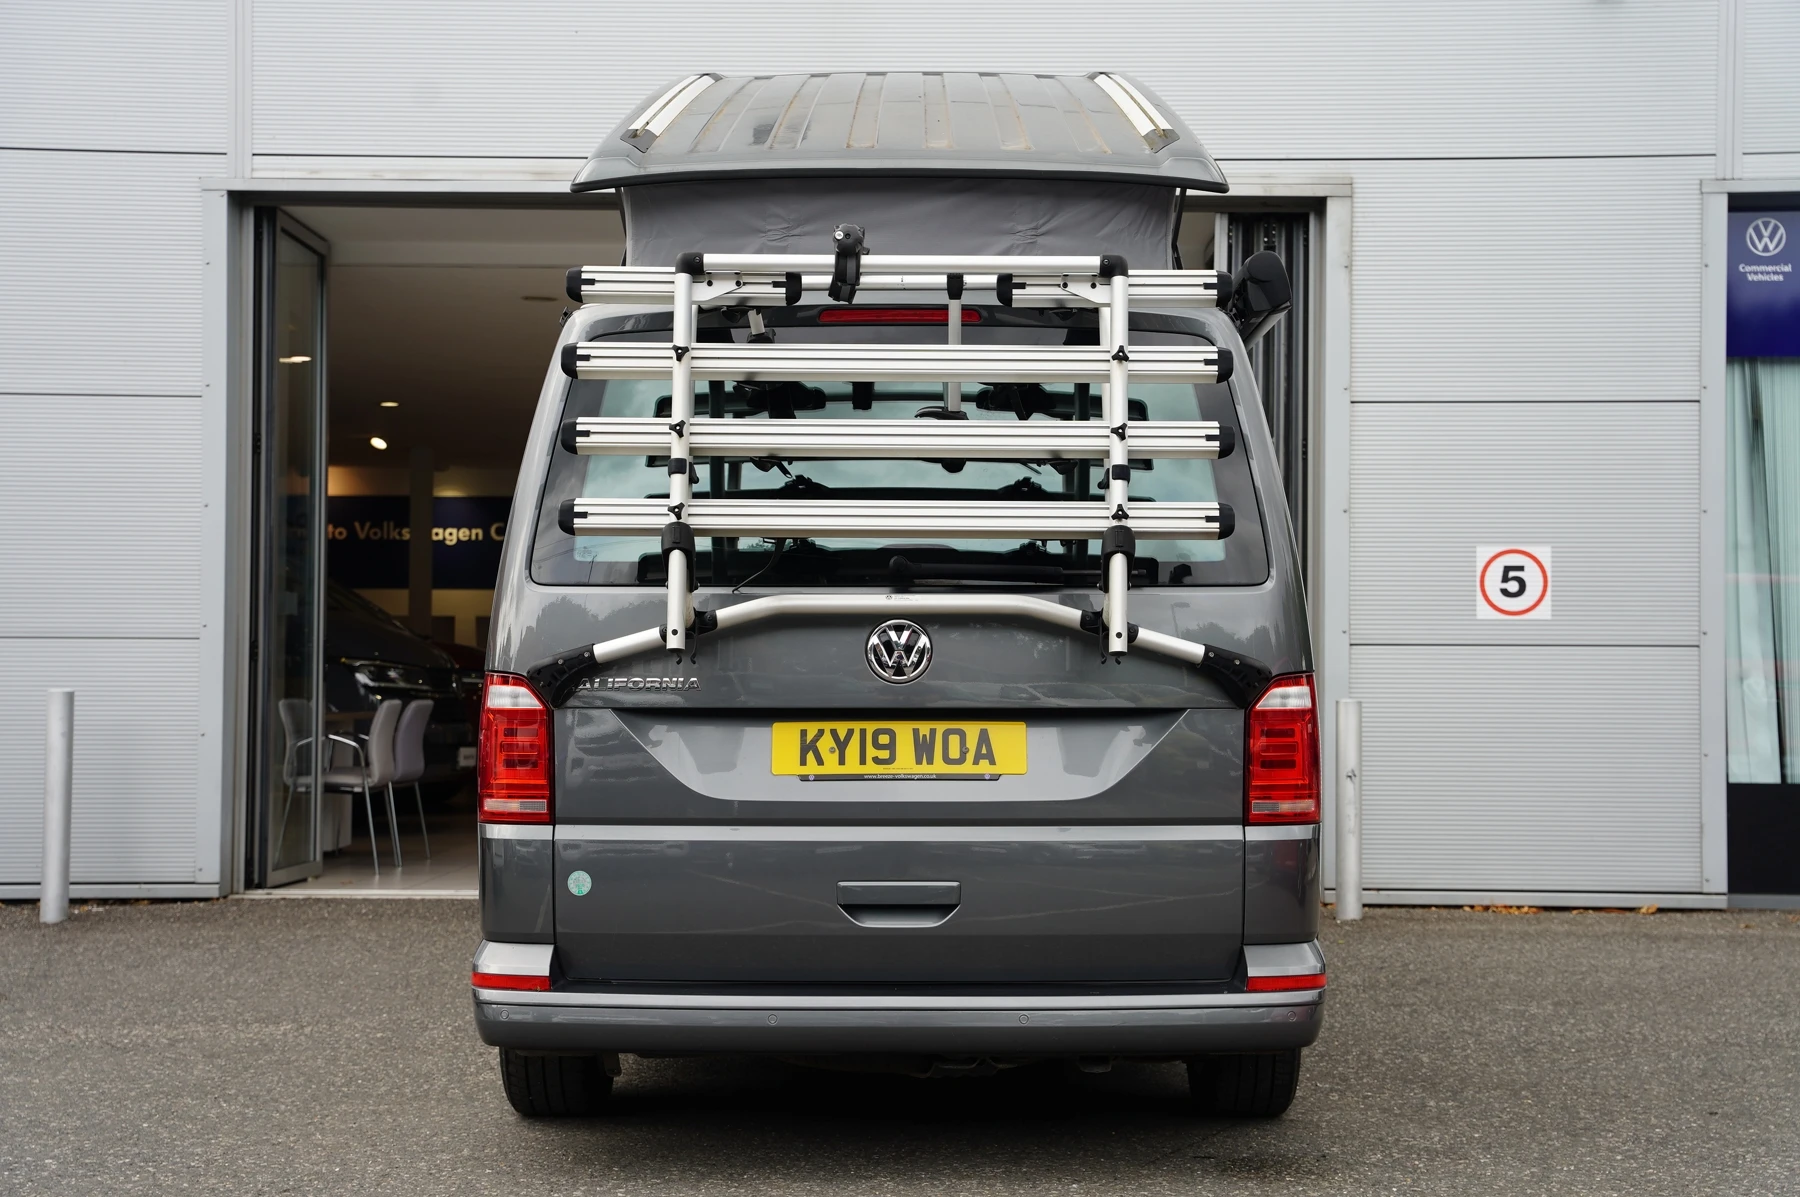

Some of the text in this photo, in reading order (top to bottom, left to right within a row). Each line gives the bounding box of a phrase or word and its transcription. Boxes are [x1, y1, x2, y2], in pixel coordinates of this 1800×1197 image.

[1738, 263, 1792, 272] Commercial
[1746, 272, 1784, 281] Vehicles
[354, 521, 483, 545] Volksagen
[1499, 565, 1527, 598] 5
[573, 677, 701, 691] ALIFORNIA
[799, 728, 997, 766] KY19 WOA
